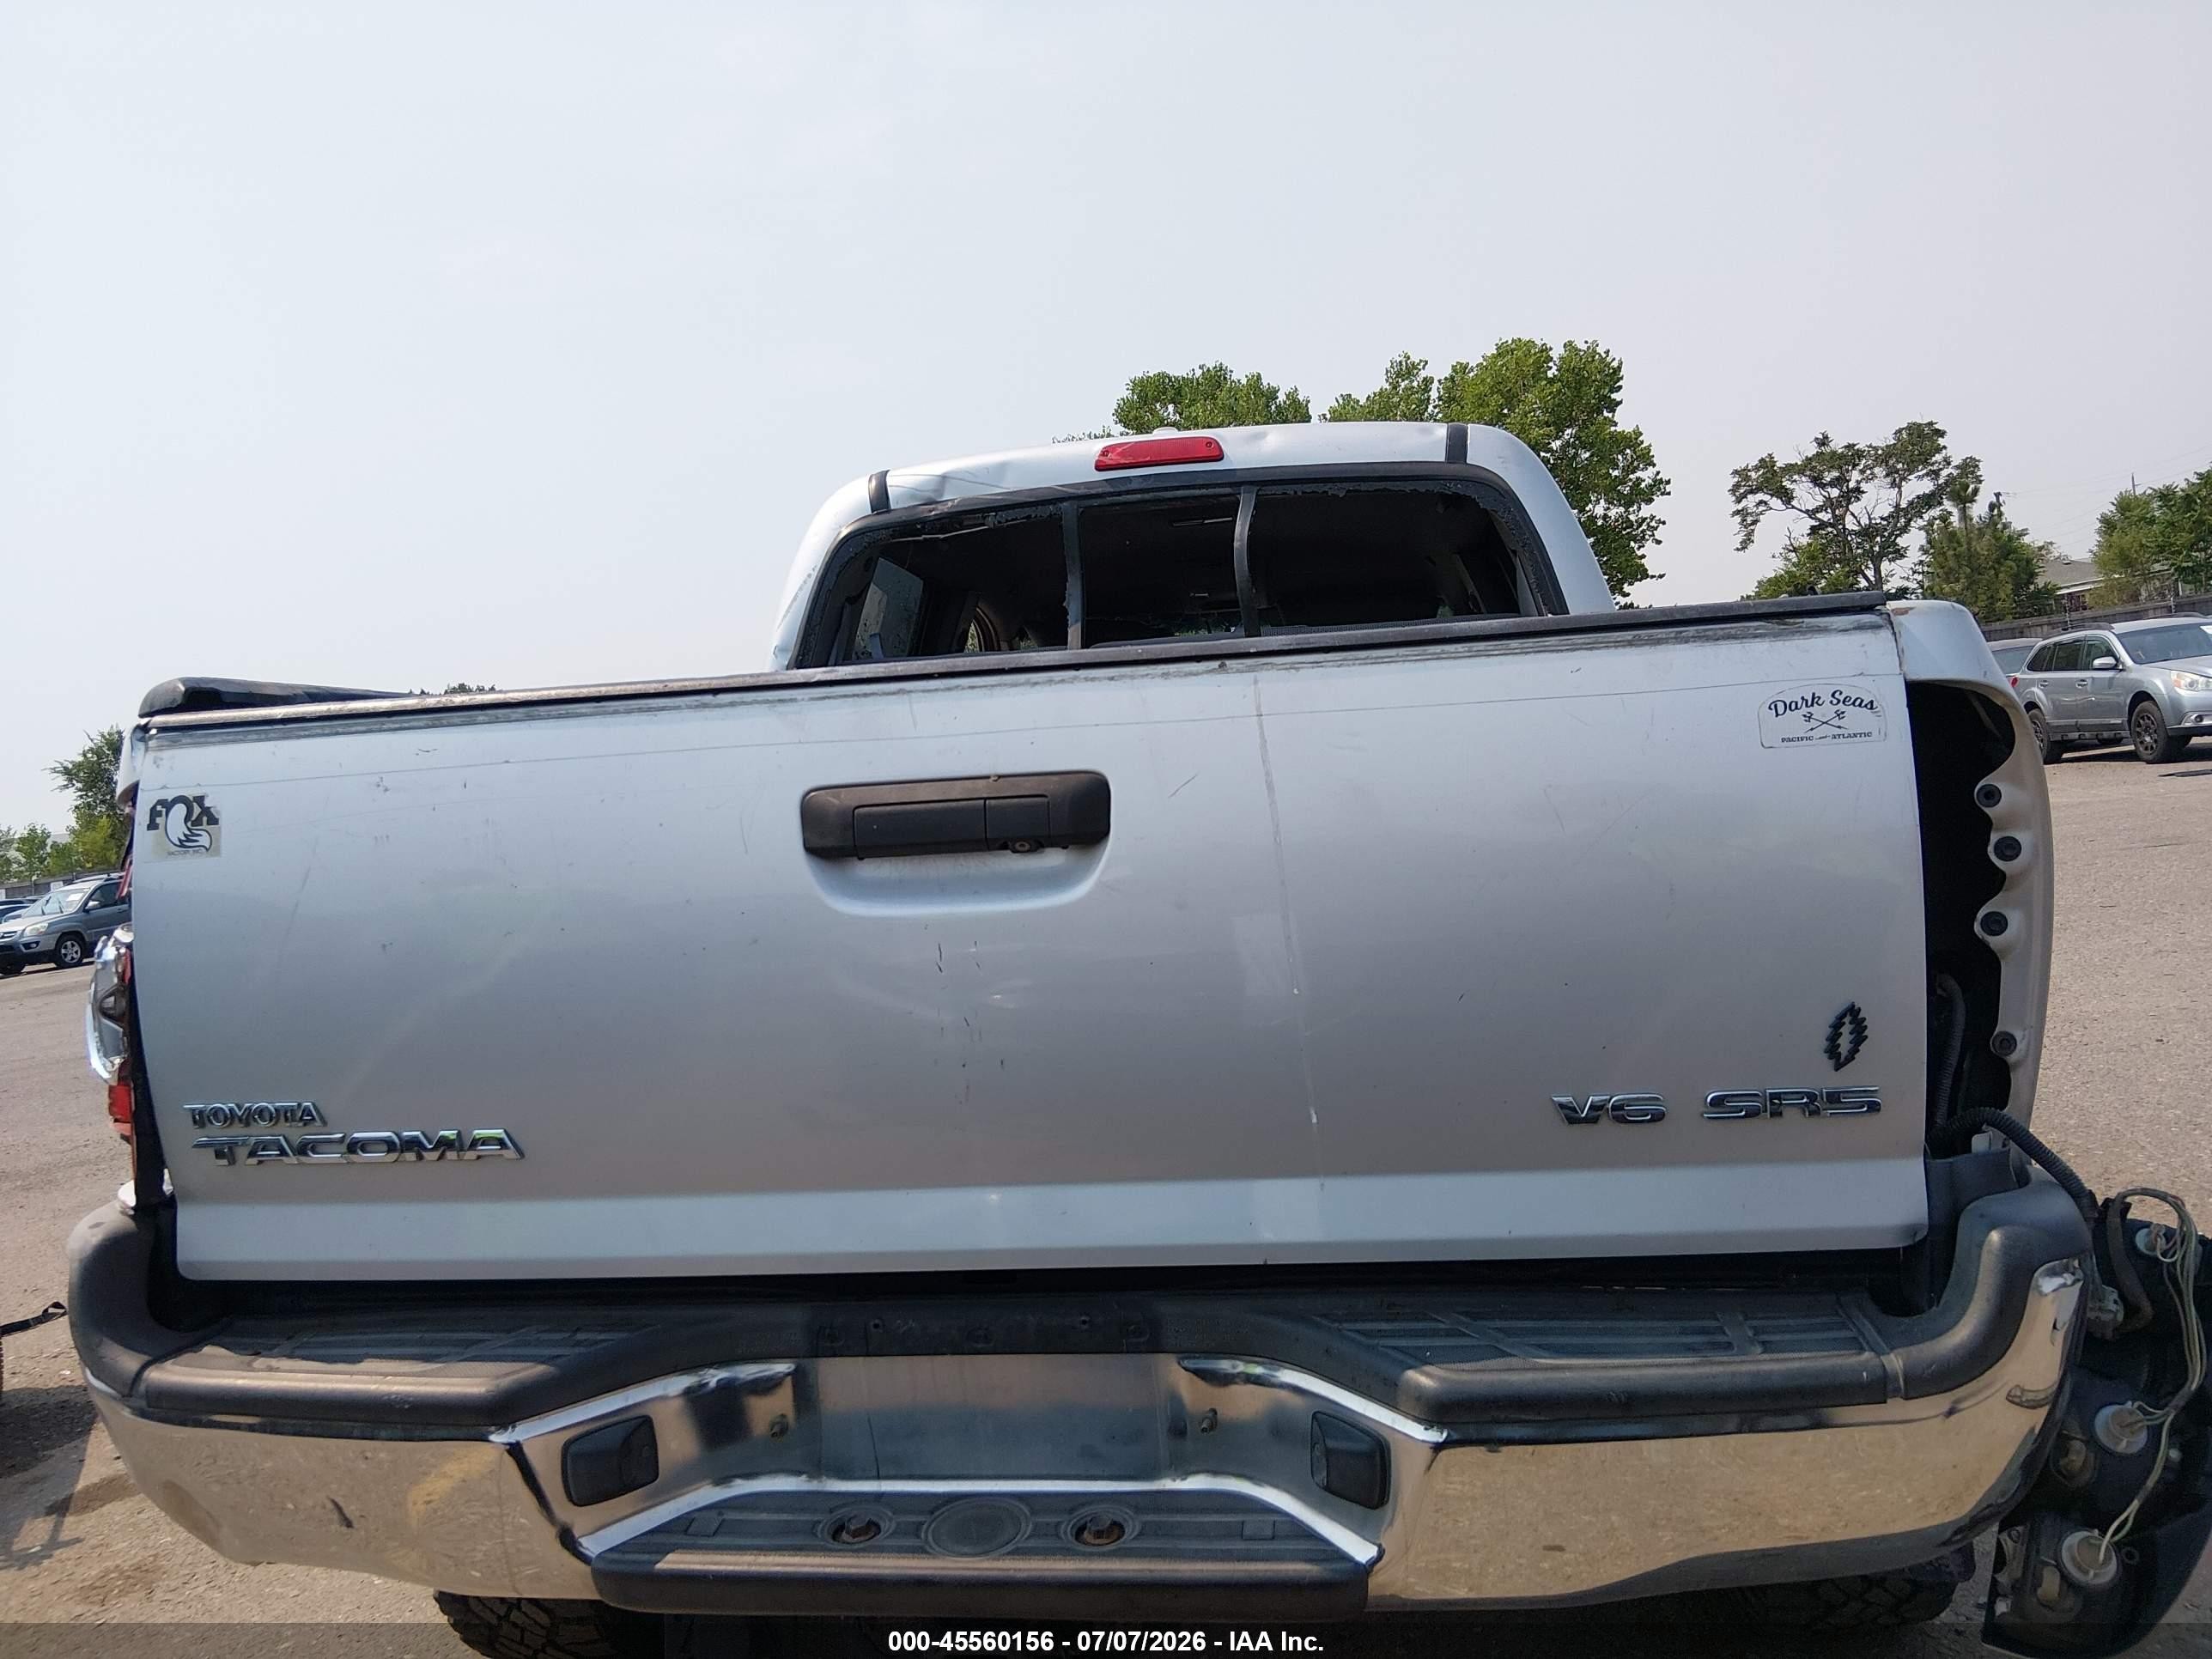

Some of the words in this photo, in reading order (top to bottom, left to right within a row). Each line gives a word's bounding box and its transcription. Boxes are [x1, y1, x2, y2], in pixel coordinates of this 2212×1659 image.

[1768, 692, 1825, 718] Dark
[1829, 690, 1878, 711] Seas
[147, 795, 220, 843] FOX
[183, 1102, 328, 1129] TOYOTA
[1551, 1093, 1667, 1125] V6
[1703, 1085, 1882, 1120] SR5
[191, 1128, 526, 1167] TACOMA
